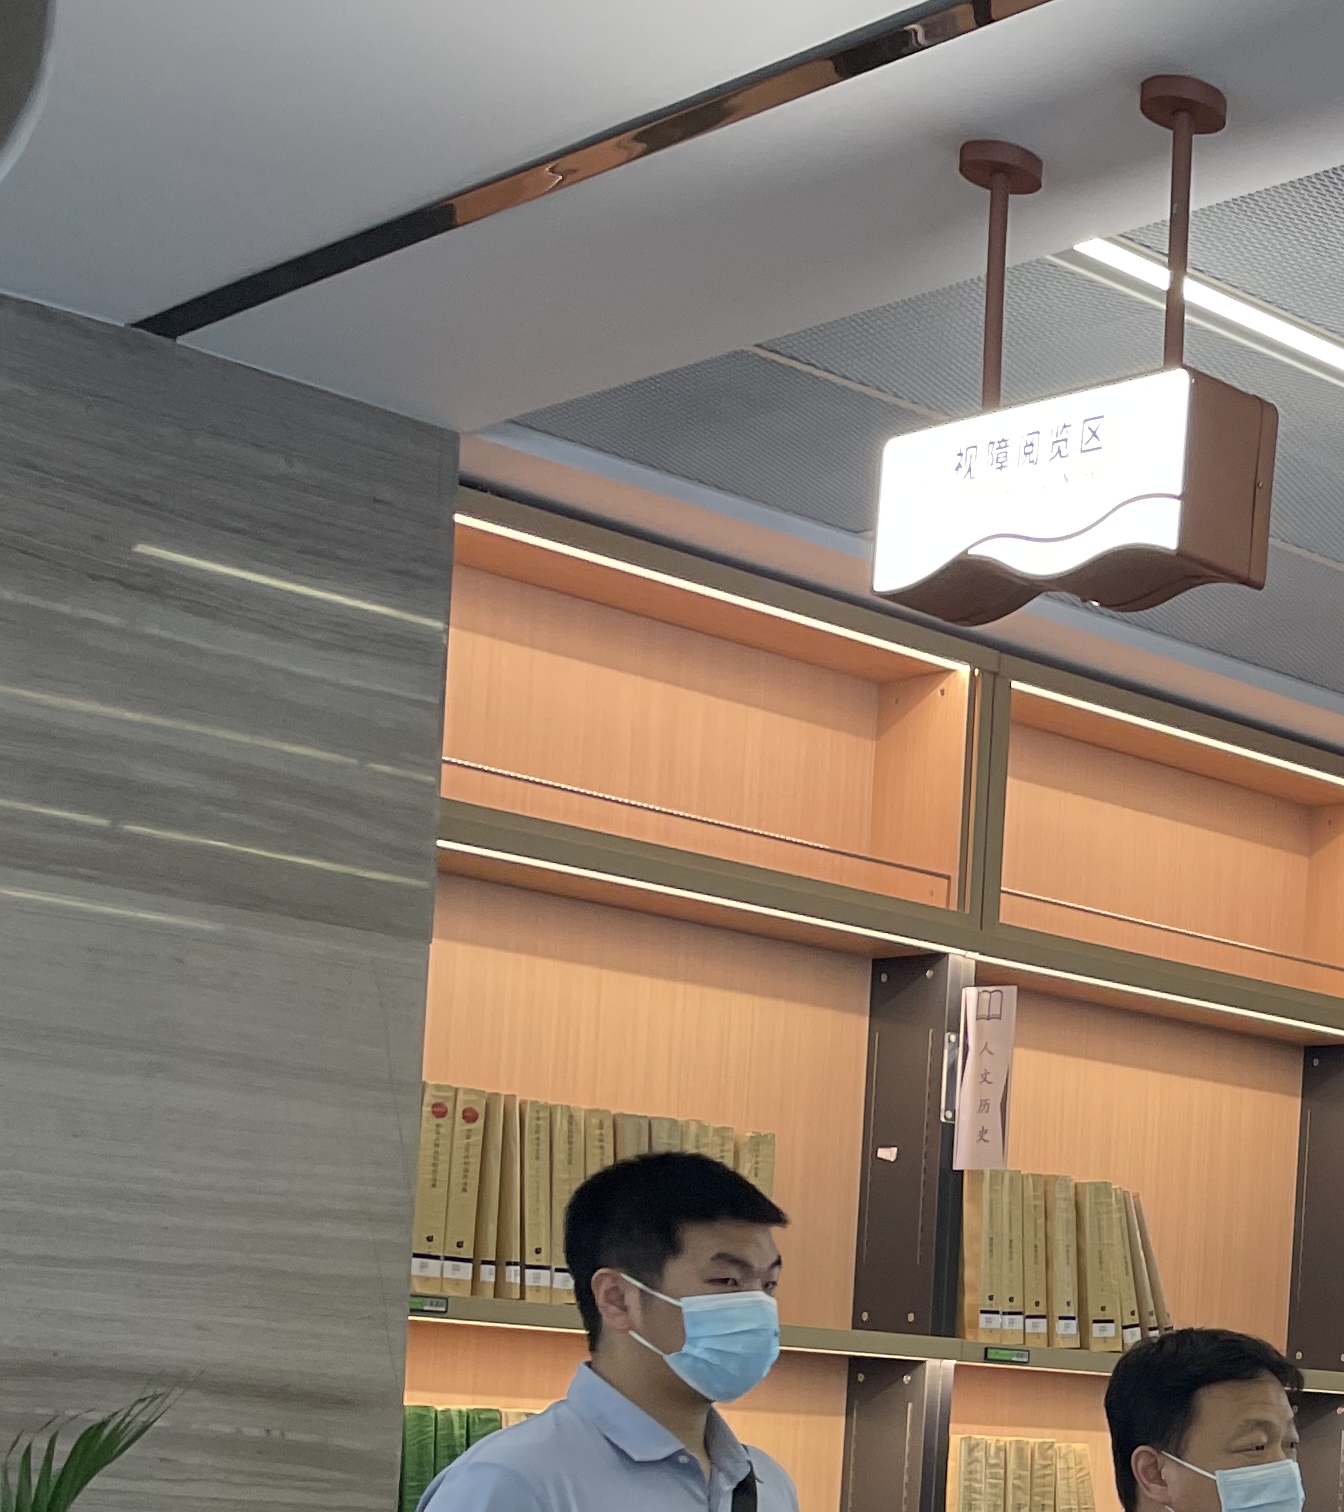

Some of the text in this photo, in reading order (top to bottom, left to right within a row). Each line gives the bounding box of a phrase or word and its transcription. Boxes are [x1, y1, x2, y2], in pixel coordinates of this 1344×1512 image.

[953, 415, 1105, 481] 视障阅览区
[976, 1040, 994, 1143] 人文历史
